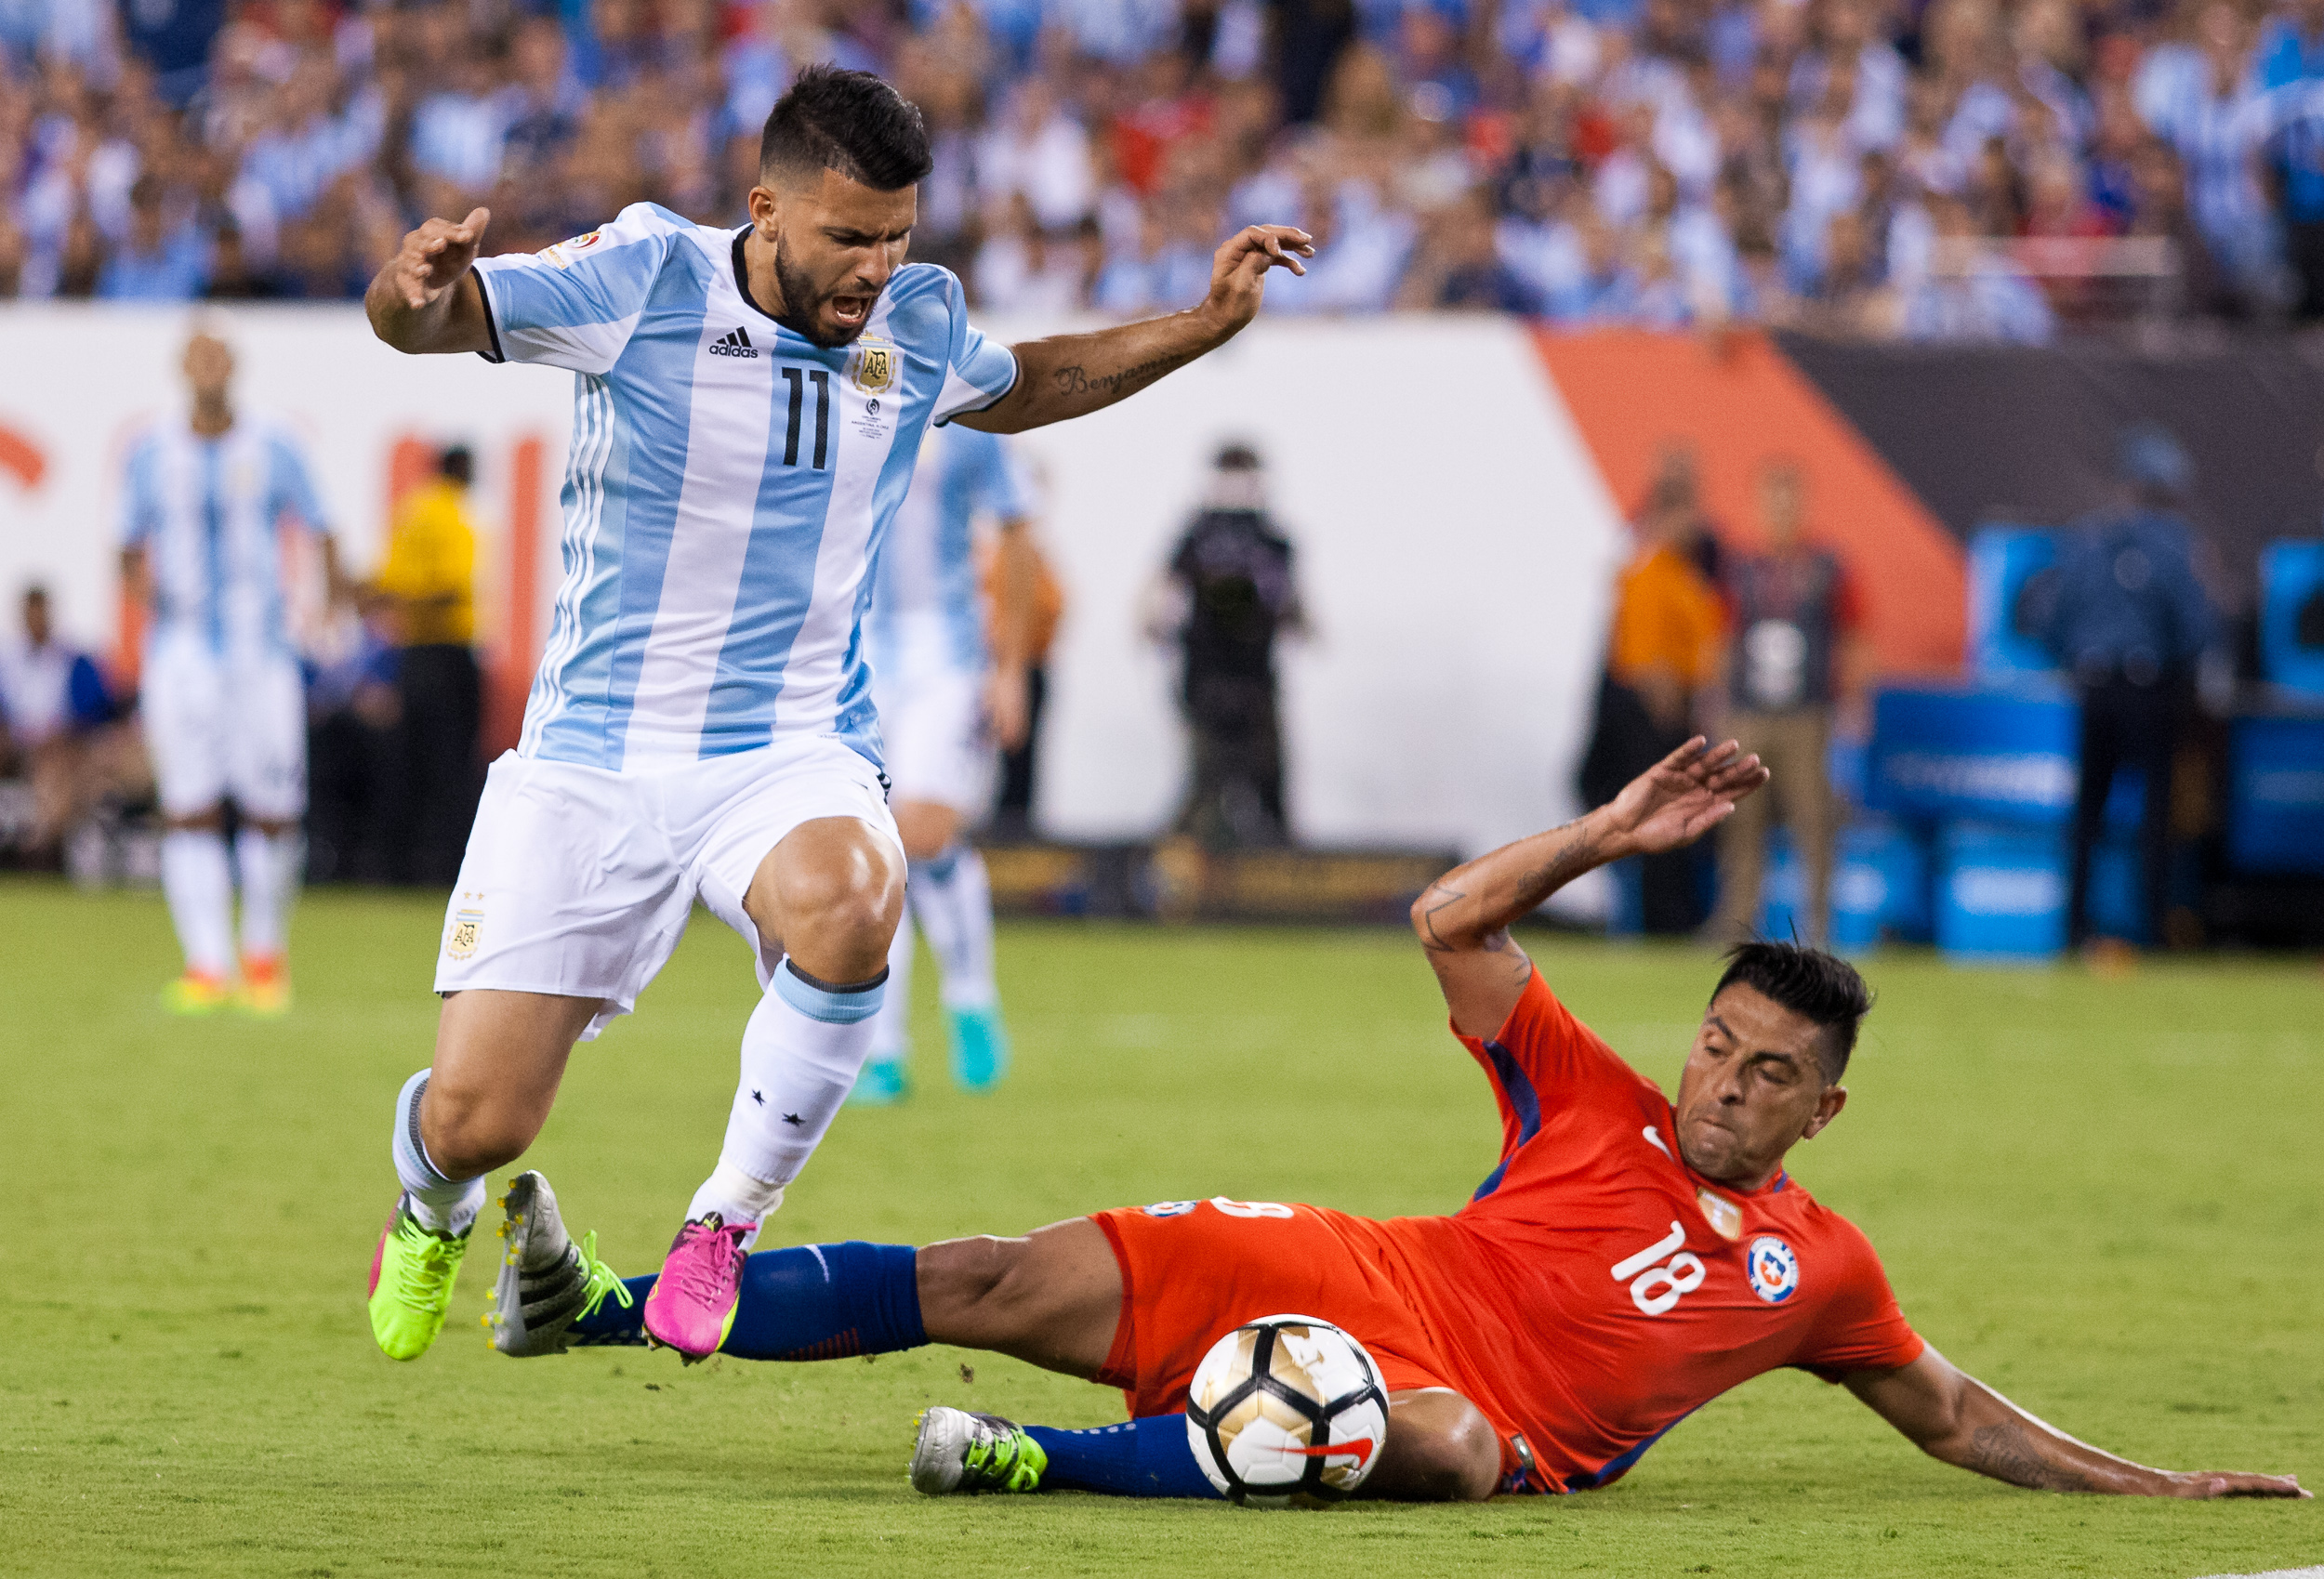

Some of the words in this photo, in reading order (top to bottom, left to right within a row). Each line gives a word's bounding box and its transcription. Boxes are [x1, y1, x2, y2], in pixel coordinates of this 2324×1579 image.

[708, 344, 759, 359] adidas
[865, 349, 888, 379] AFA
[781, 366, 830, 470] 11
[454, 923, 475, 947] AFA
[1610, 1219, 1707, 1317] 18
